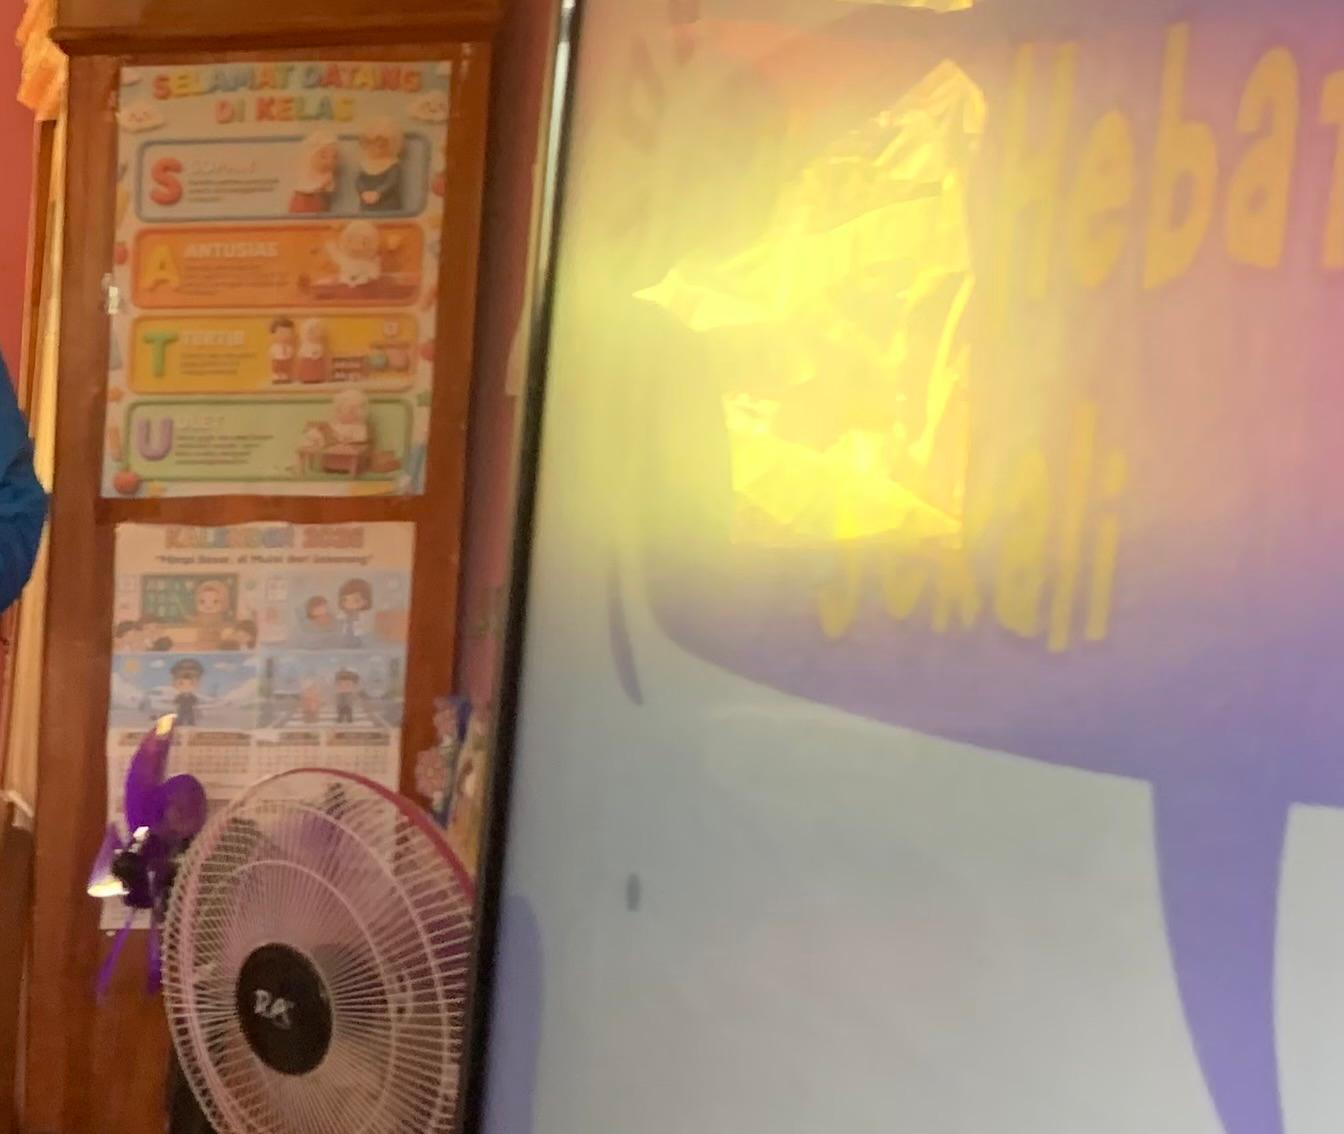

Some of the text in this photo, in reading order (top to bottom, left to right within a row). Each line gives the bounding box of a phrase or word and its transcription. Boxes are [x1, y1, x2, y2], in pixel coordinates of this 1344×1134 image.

[216, 97, 246, 124] DI
[150, 157, 183, 206] S
[141, 245, 181, 292] A
[143, 331, 179, 378] T
[136, 416, 174, 462] U
